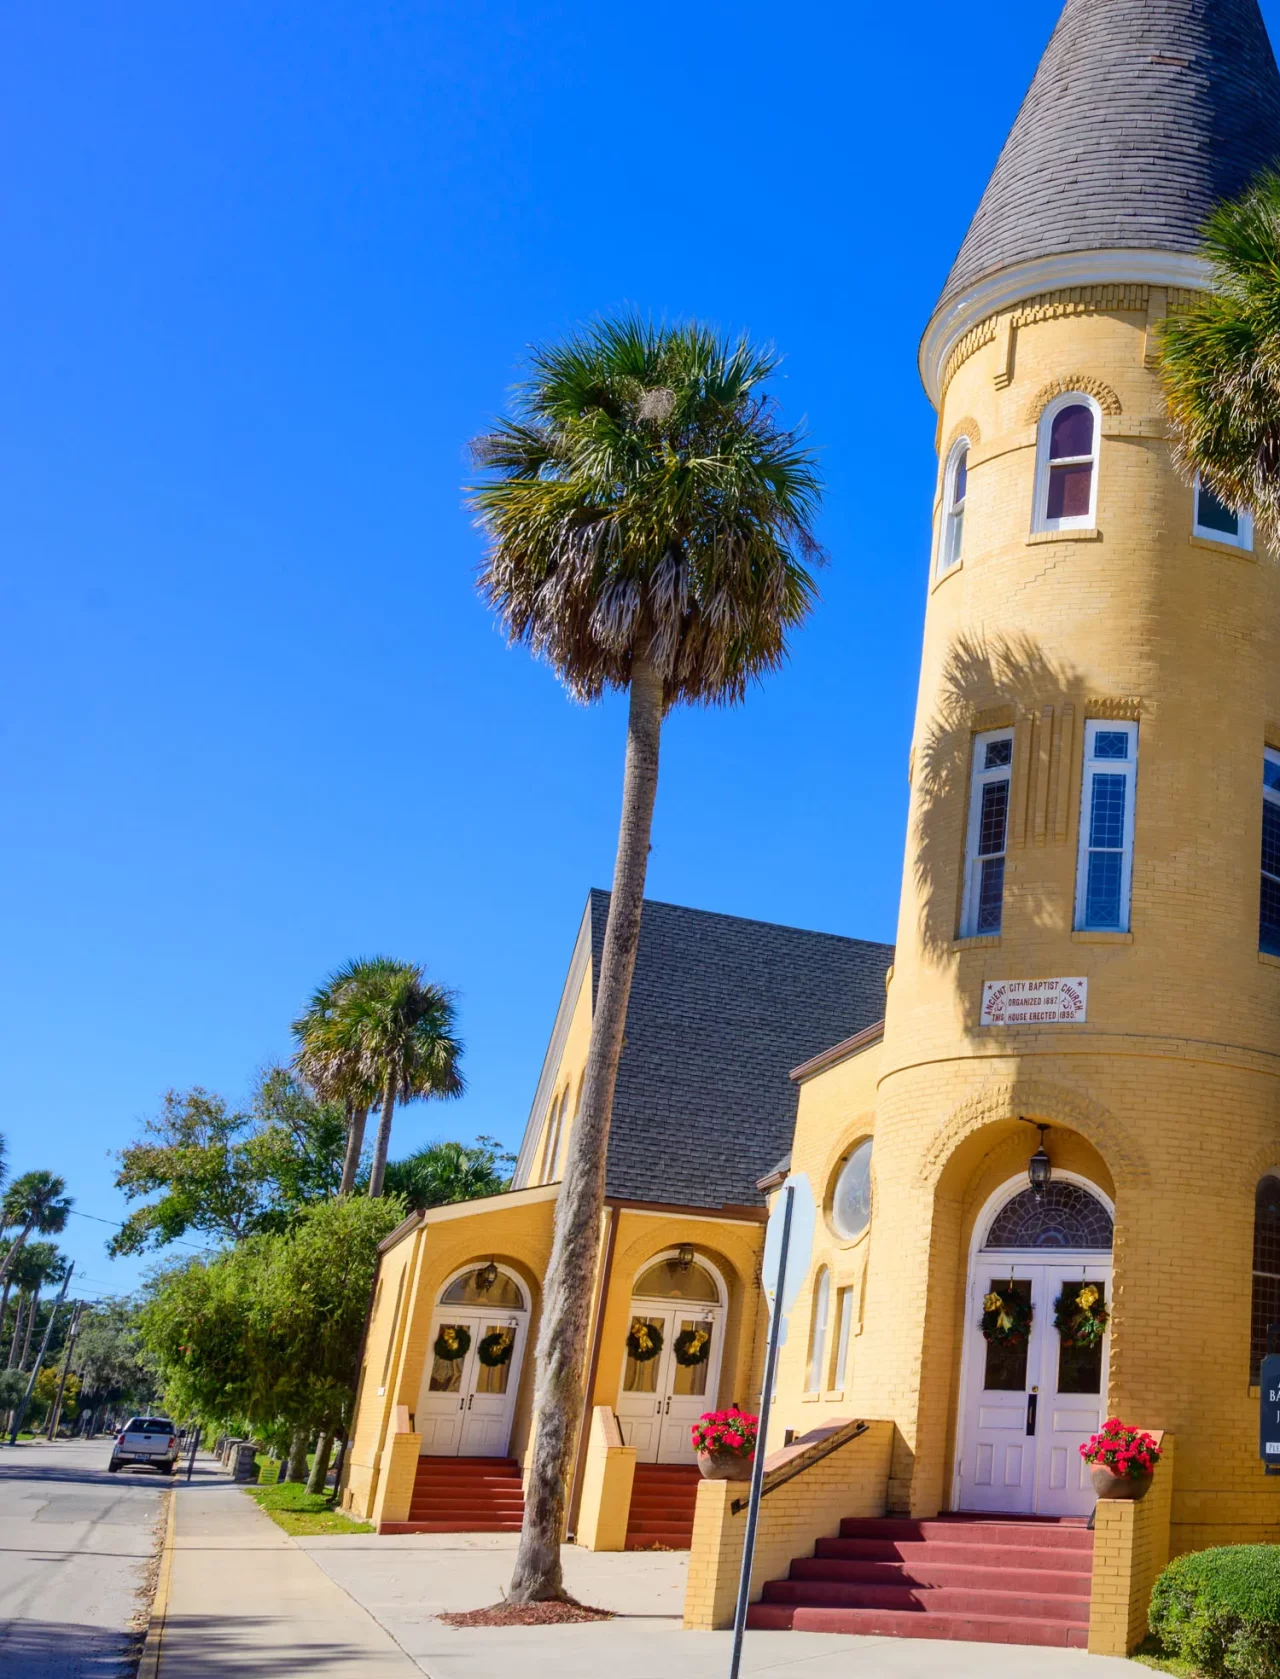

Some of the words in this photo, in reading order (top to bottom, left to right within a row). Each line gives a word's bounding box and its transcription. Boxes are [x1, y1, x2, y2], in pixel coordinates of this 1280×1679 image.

[984, 985, 1007, 1016] ANCIENT
[1009, 983, 1026, 993] CITY
[1028, 981, 1060, 992] BAPTIST
[1060, 983, 1083, 1011] CHURCH
[1008, 997, 1042, 1007] ORGANIZED
[992, 1013, 1005, 1022] THIS
[1008, 1012, 1027, 1021] HOUSE
[1029, 1011, 1057, 1020] ERECTED
